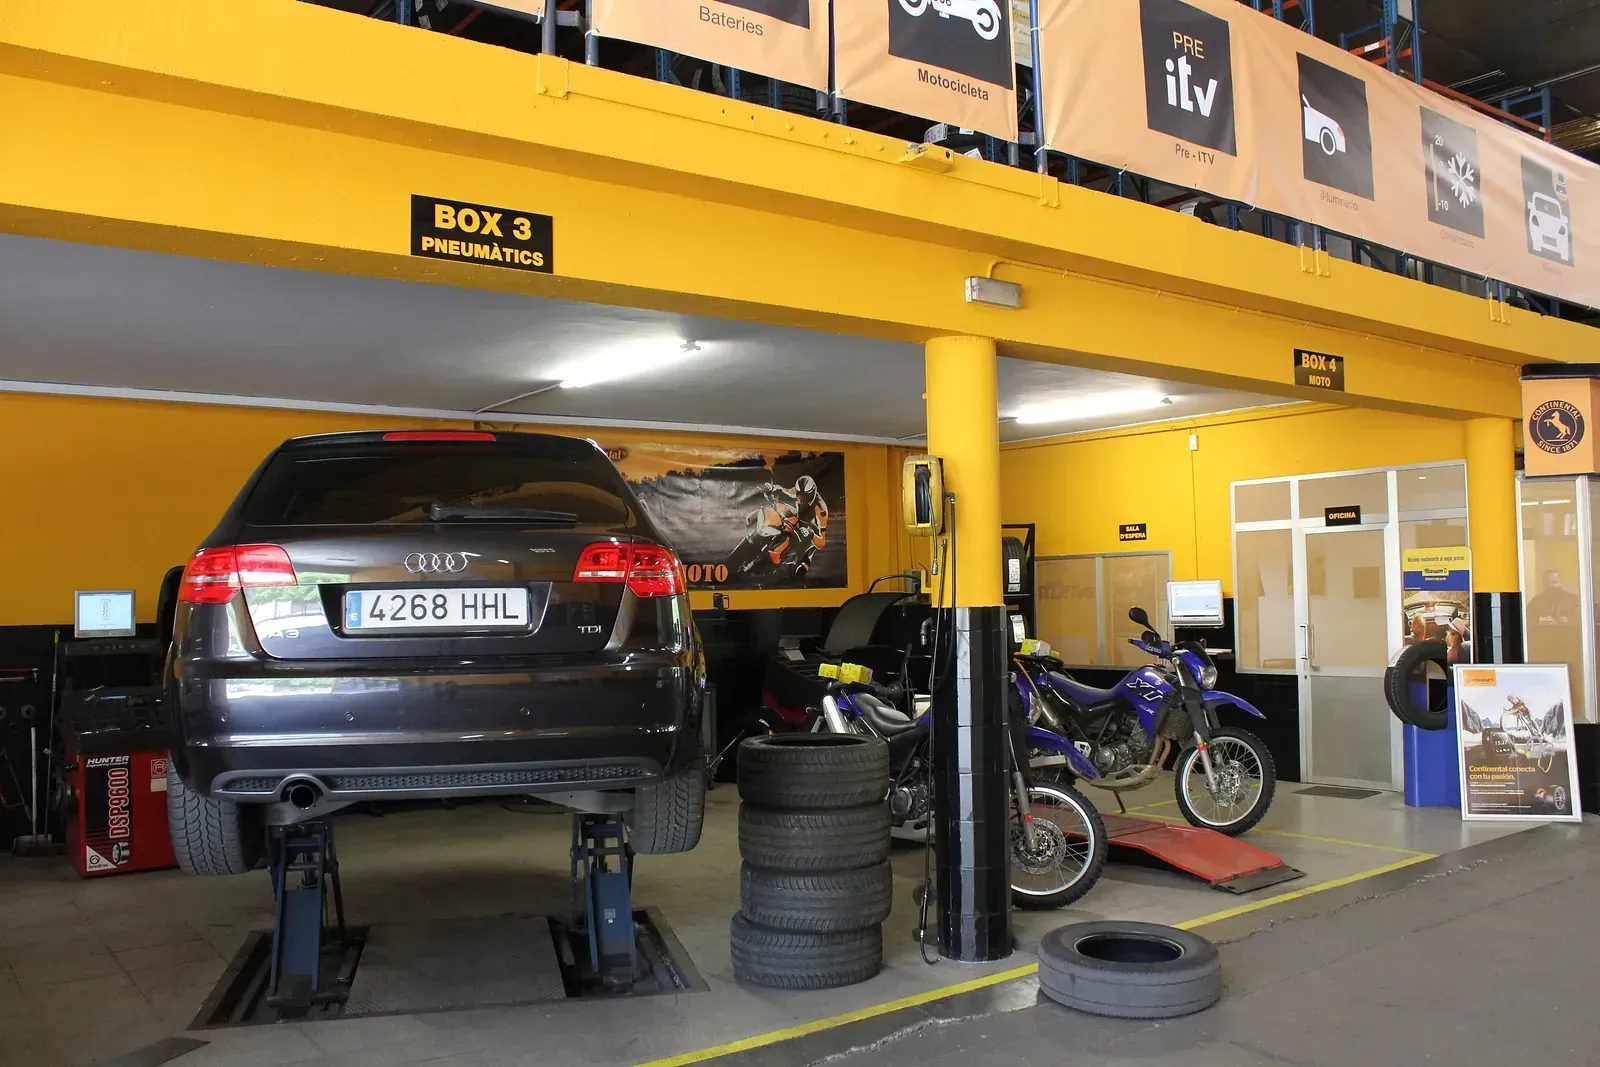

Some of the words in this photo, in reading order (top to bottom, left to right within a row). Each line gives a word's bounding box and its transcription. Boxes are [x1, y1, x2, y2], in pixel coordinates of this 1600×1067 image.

[699, 5, 764, 36] Bateries
[1172, 31, 1205, 59] PRE
[917, 67, 989, 101] Motocicleta
[1165, 55, 1218, 118] itv
[1434, 134, 1444, 147] 20
[1175, 143, 1190, 159] Pre
[1198, 151, 1215, 165] ITV
[434, 203, 504, 238] BOX
[512, 216, 532, 241] 3
[421, 235, 544, 267] PNEUMÀTICS
[1301, 352, 1327, 371] BOX
[1329, 357, 1337, 373] 4
[1308, 374, 1331, 387] MOTO
[1531, 401, 1581, 421] CONTINENTAL
[1537, 440, 1561, 454] SINCE
[1561, 439, 1578, 452] 1871
[1328, 511, 1357, 520] OFICINA
[1120, 532, 1146, 540] D'ESPERA
[369, 593, 449, 621] 4268
[461, 592, 519, 620] HHL
[351, 613, 358, 621] E
[577, 625, 602, 634] TDI
[86, 755, 130, 765] HUNTER
[1468, 765, 1508, 773] Continental
[1491, 773, 1516, 781] pasión.
[107, 767, 130, 839] DSP9600
